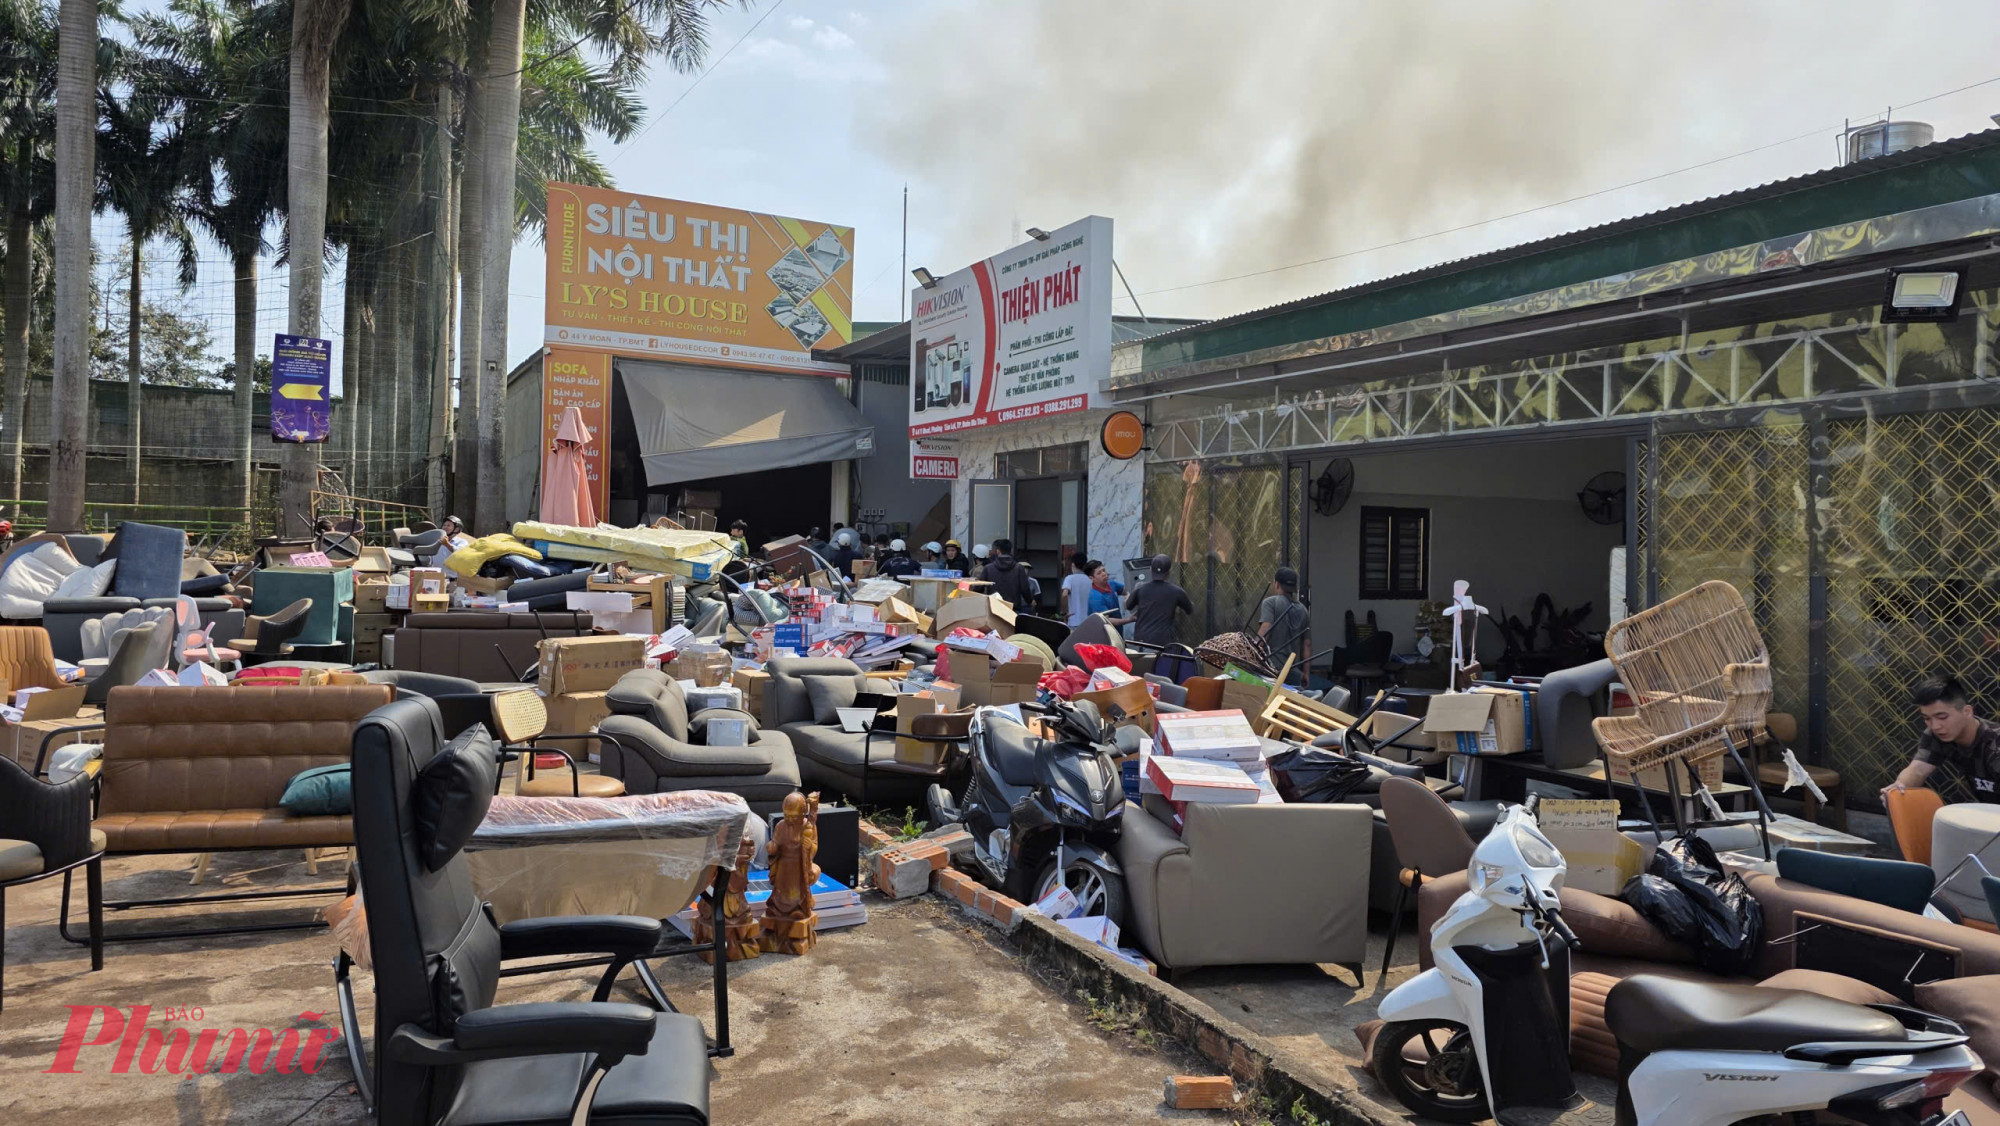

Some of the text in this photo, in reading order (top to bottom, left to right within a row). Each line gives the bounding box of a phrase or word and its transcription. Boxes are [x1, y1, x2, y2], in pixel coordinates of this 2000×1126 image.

[562, 202, 575, 274] FURNITURE
[585, 199, 751, 263] SIÊU THỊ
[588, 243, 753, 294] NỘI THẤT
[1002, 276, 1040, 324] THIỆN
[1043, 261, 1081, 311] PHÁT
[560, 282, 749, 324] LY'S HOUSE
[917, 285, 965, 318] HIKVISION
[659, 320, 674, 329] THI
[553, 362, 588, 376] SOFA
[1004, 365, 1019, 375] CAMERA
[568, 400, 584, 408] CAO
[919, 443, 952, 451] HIKVISION
[915, 459, 957, 476] CAMERA
[1702, 1072, 1781, 1083] VISION
